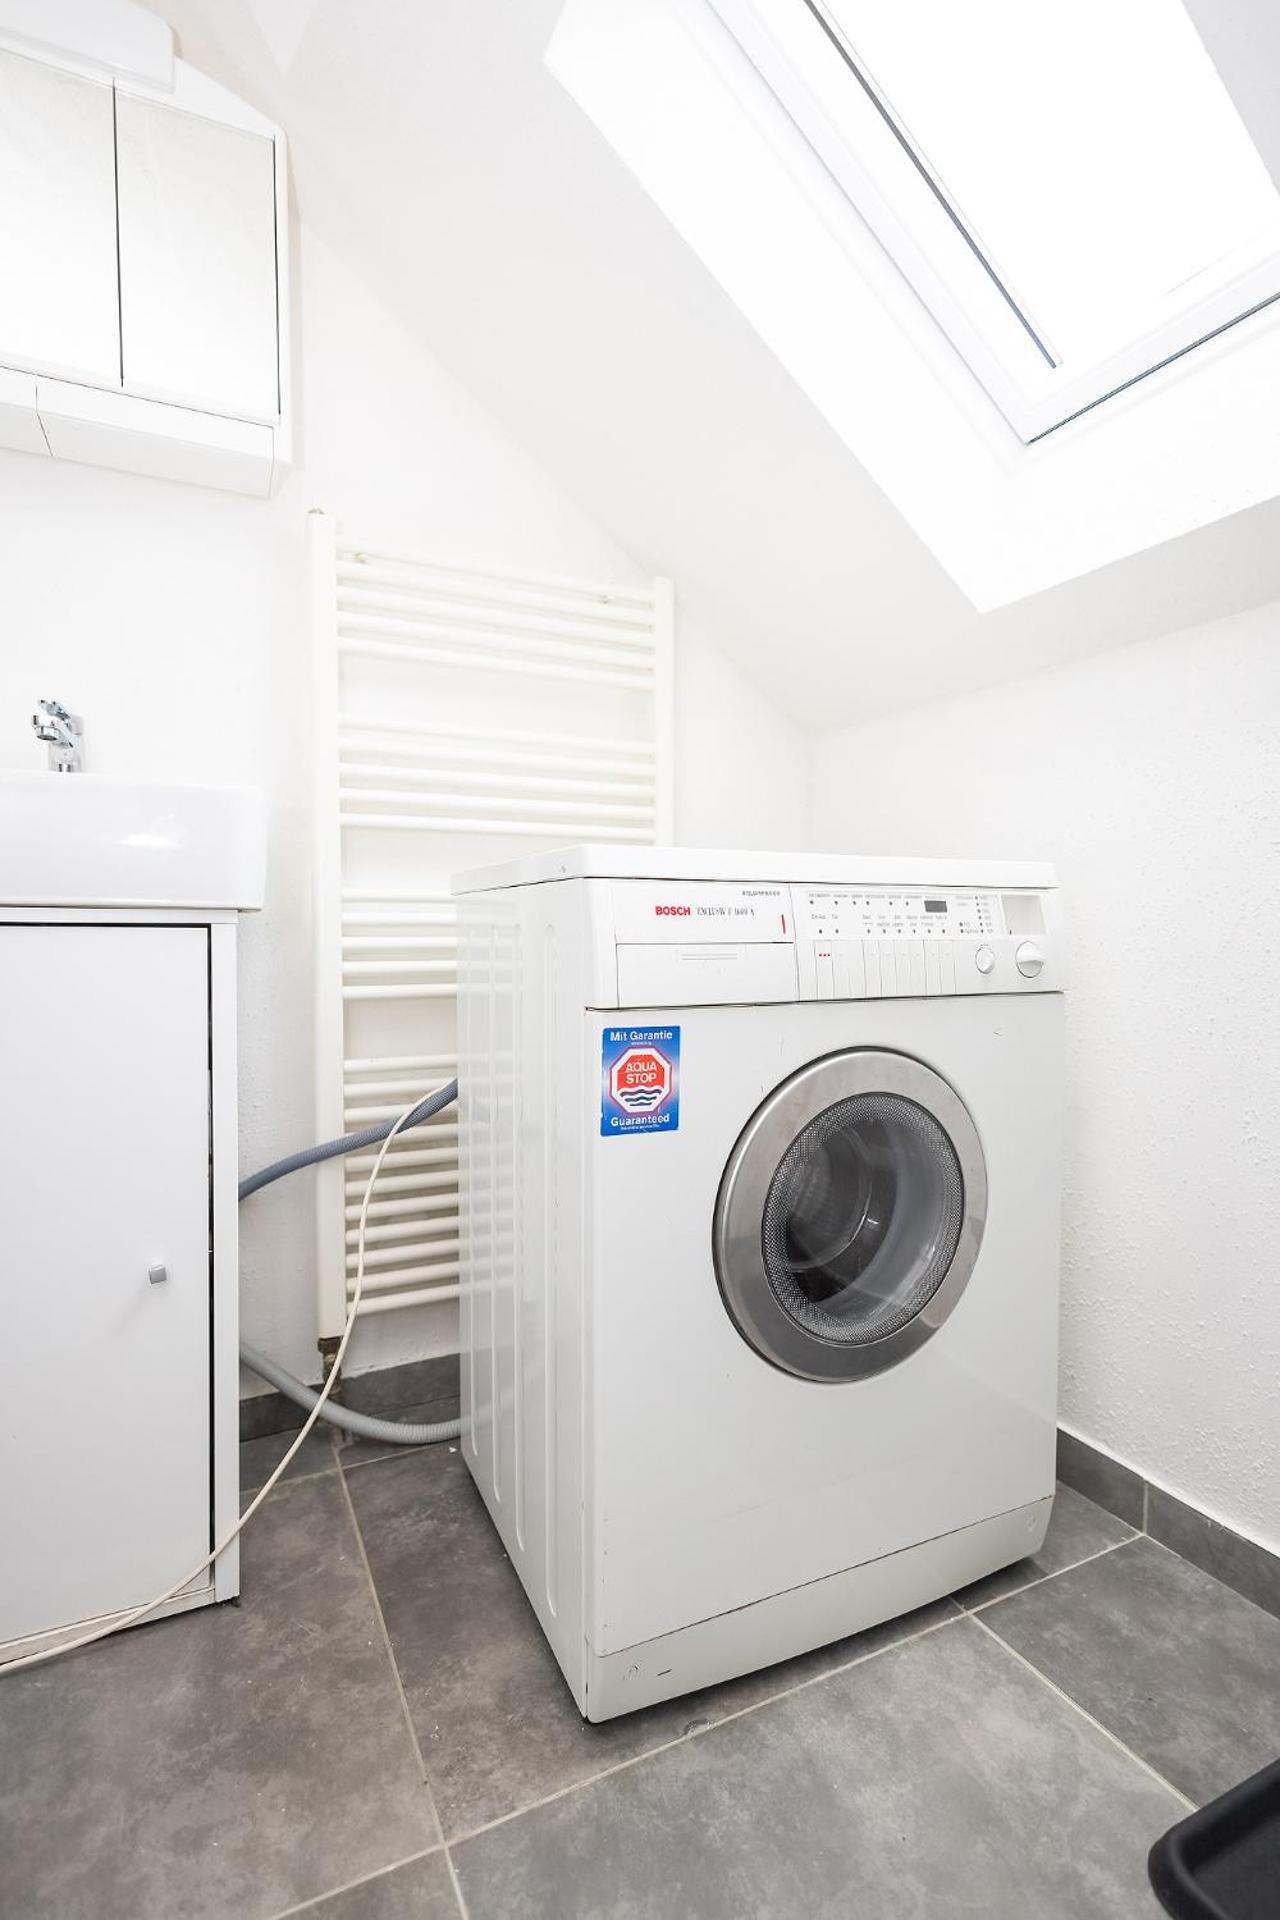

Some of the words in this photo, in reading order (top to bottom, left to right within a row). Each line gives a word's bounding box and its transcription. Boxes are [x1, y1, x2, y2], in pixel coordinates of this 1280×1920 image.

[655, 906, 691, 916] BOSCH
[610, 1031, 627, 1041] Mit
[630, 1030, 673, 1041] Garantie
[625, 1061, 657, 1073] AQUA
[626, 1073, 657, 1084] STOP
[610, 1113, 670, 1127] Guaranteed
